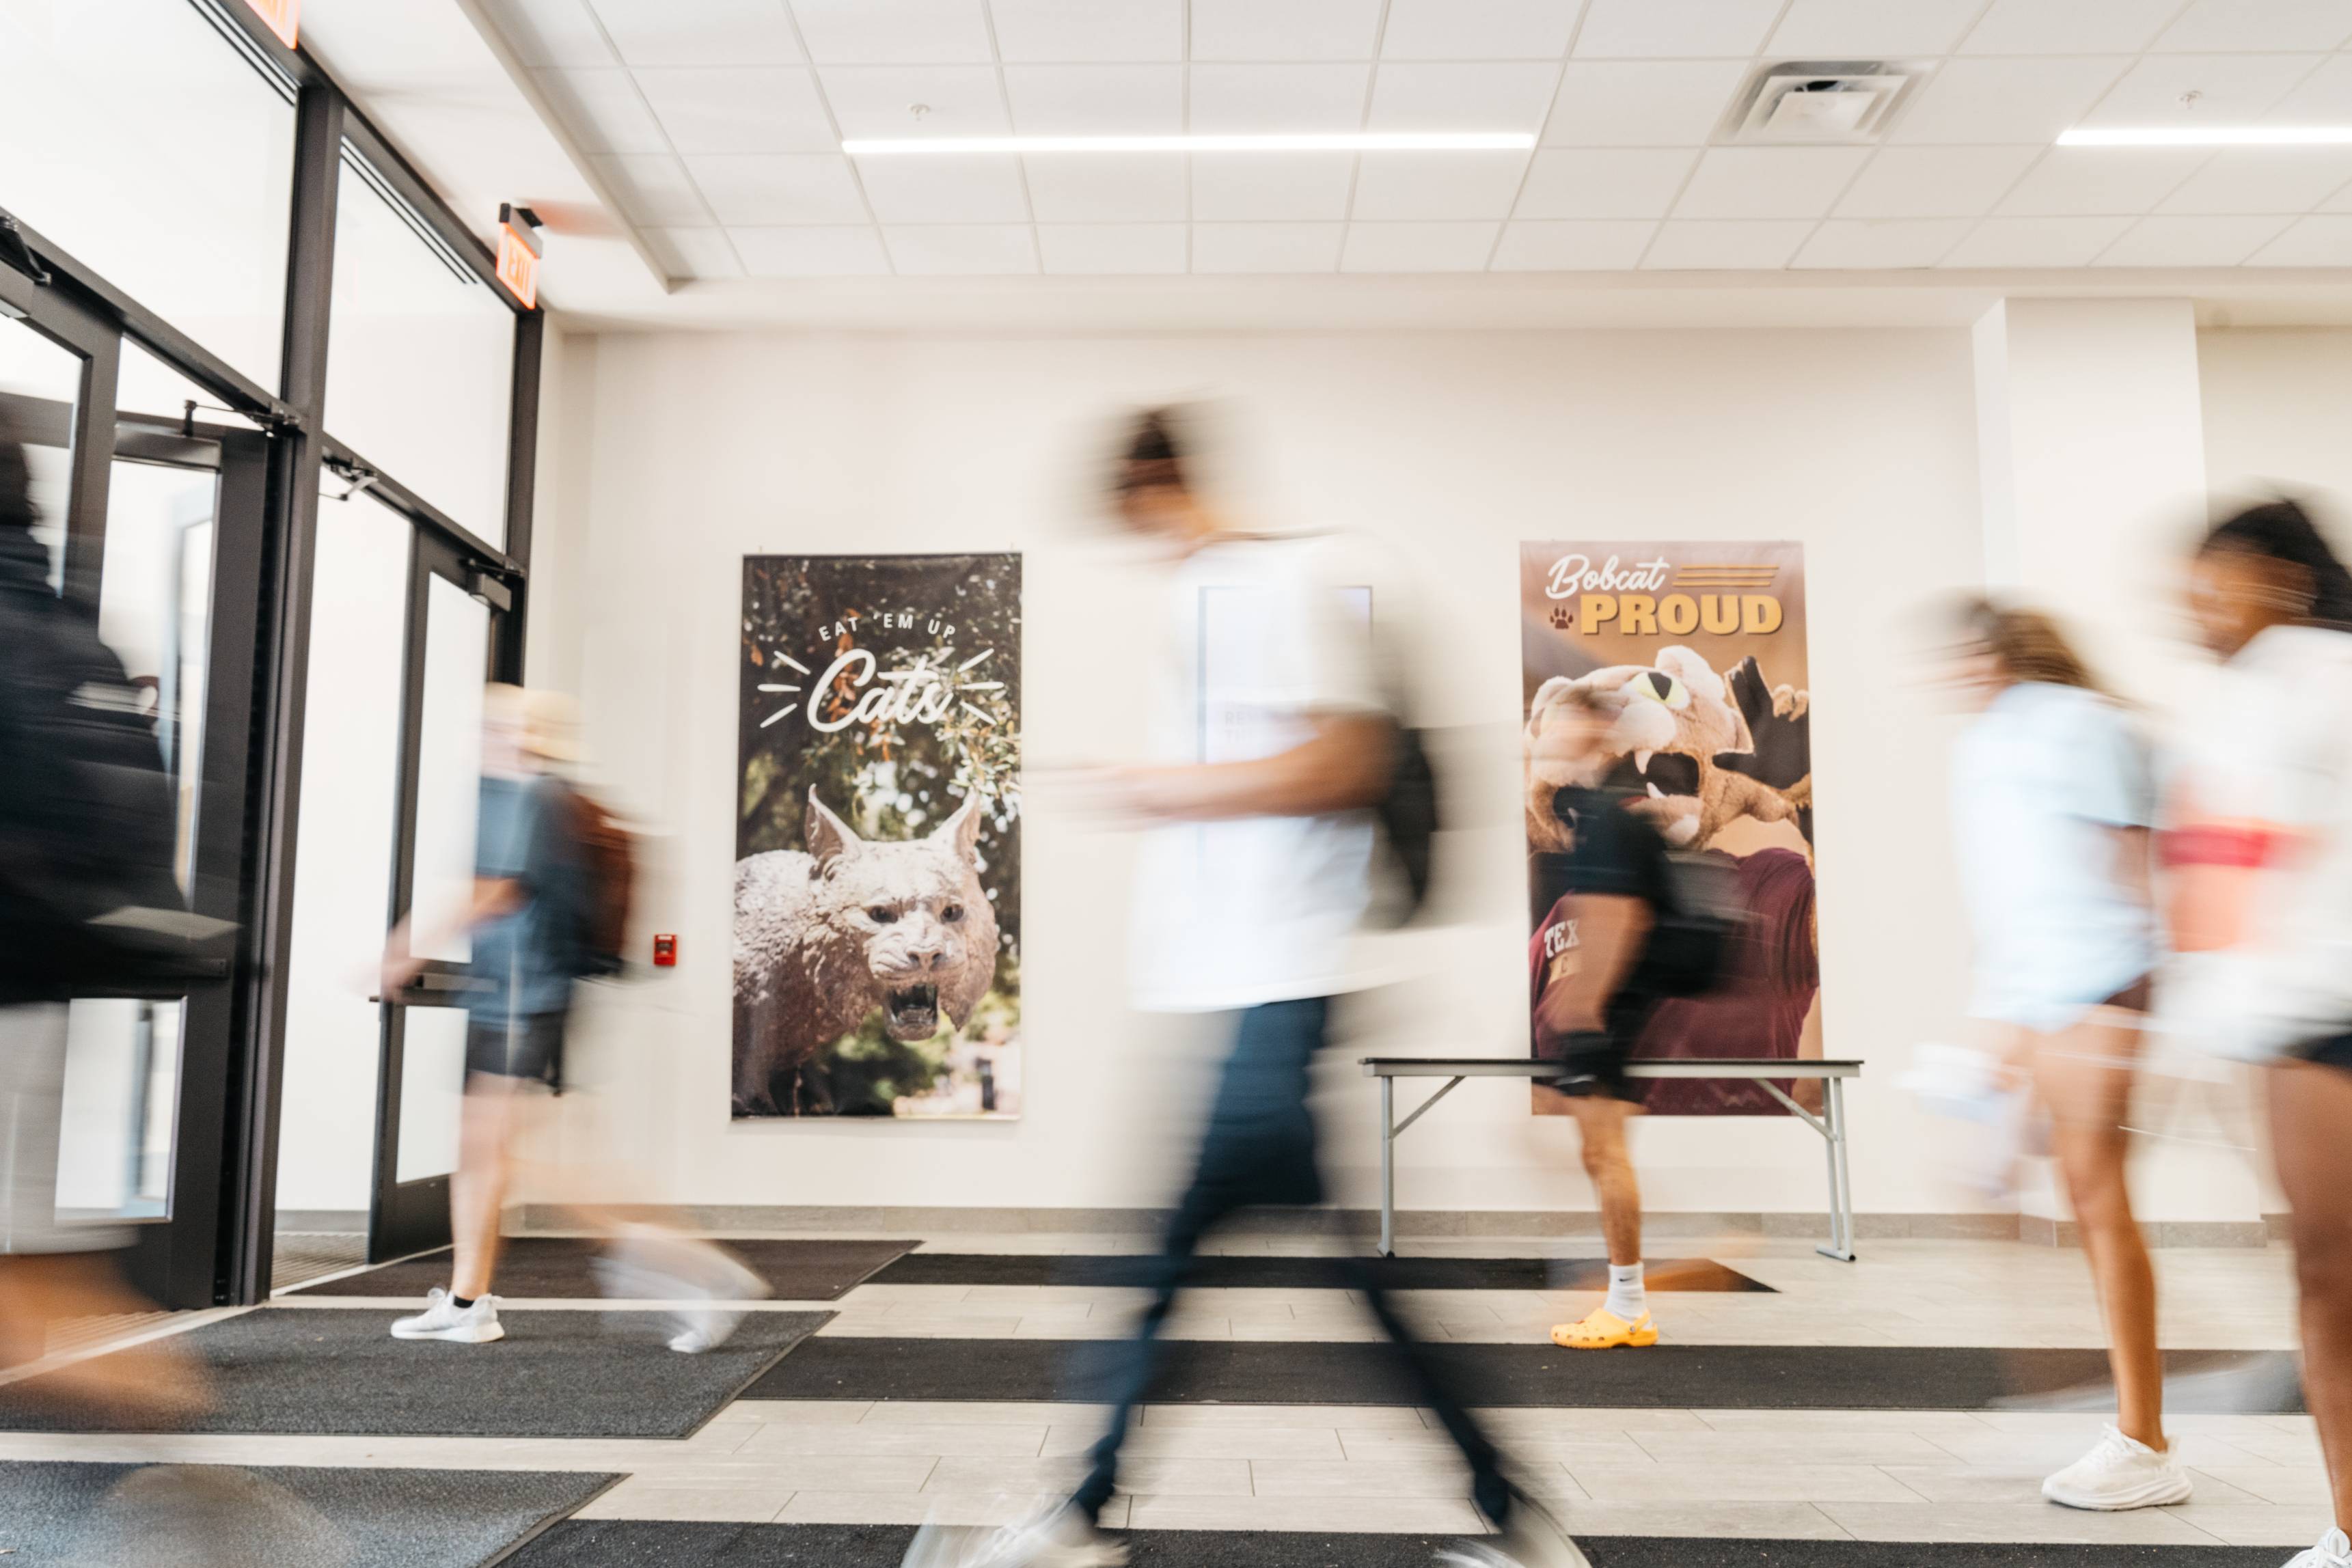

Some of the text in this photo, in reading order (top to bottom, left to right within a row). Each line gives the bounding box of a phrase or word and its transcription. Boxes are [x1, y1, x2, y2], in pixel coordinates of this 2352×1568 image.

[1545, 553, 1671, 600] Bobcat
[819, 612, 956, 642] EAT 'EM UP
[1580, 593, 1783, 635] PROUD
[807, 648, 954, 732] Cats
[1544, 918, 1581, 958] TEX
